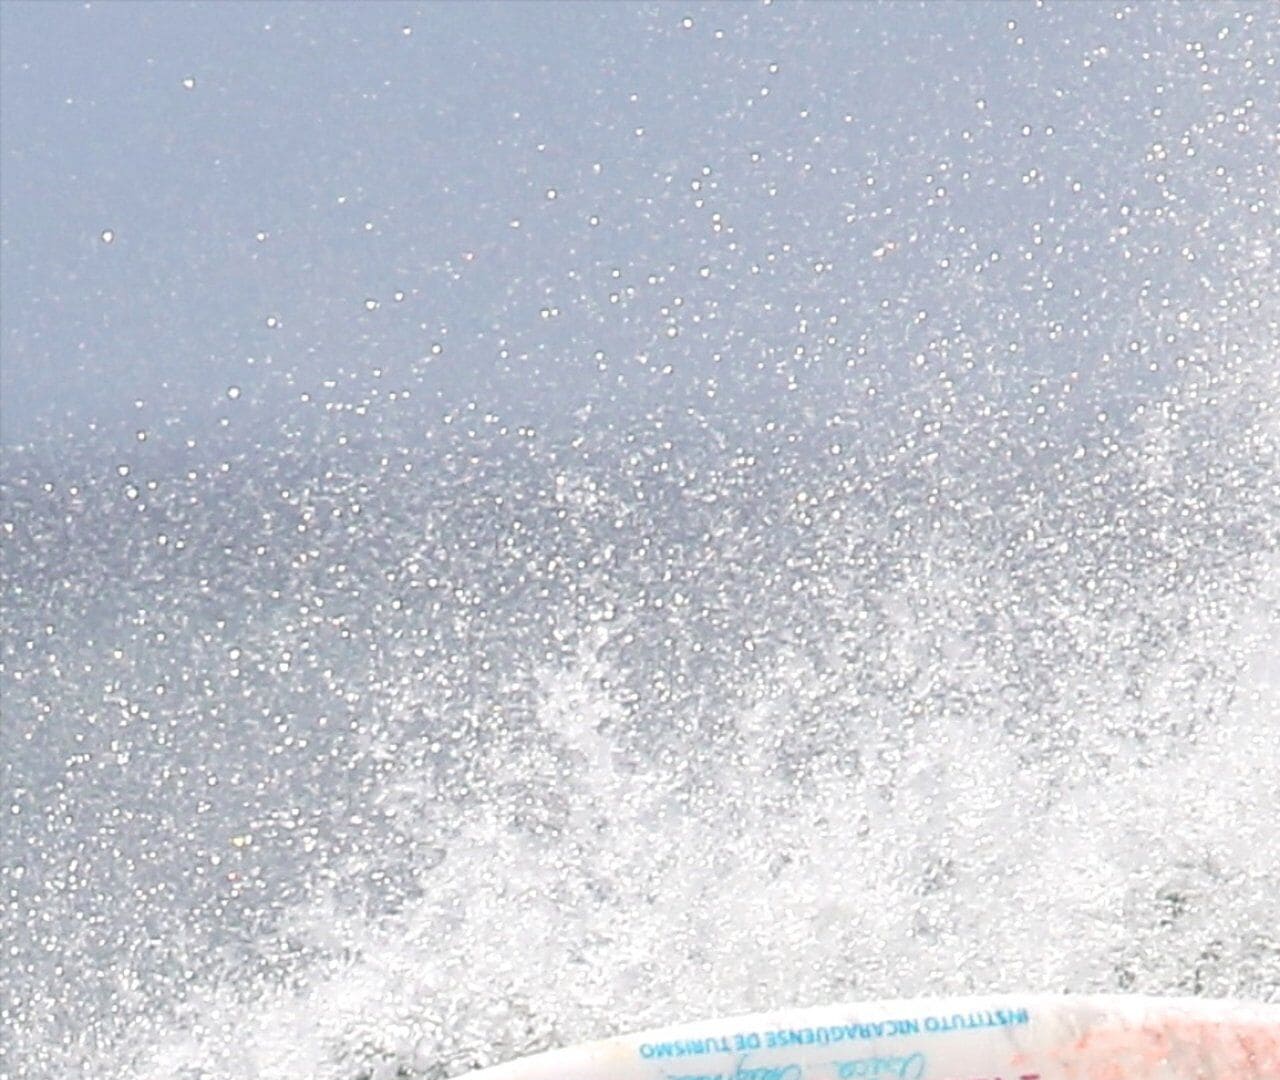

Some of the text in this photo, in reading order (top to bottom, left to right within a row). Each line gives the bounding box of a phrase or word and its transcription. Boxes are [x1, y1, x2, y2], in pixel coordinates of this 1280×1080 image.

[923, 1008, 1029, 1033] INSTITUTO
[639, 1035, 730, 1059] TURISMO
[734, 1032, 761, 1050] DE
